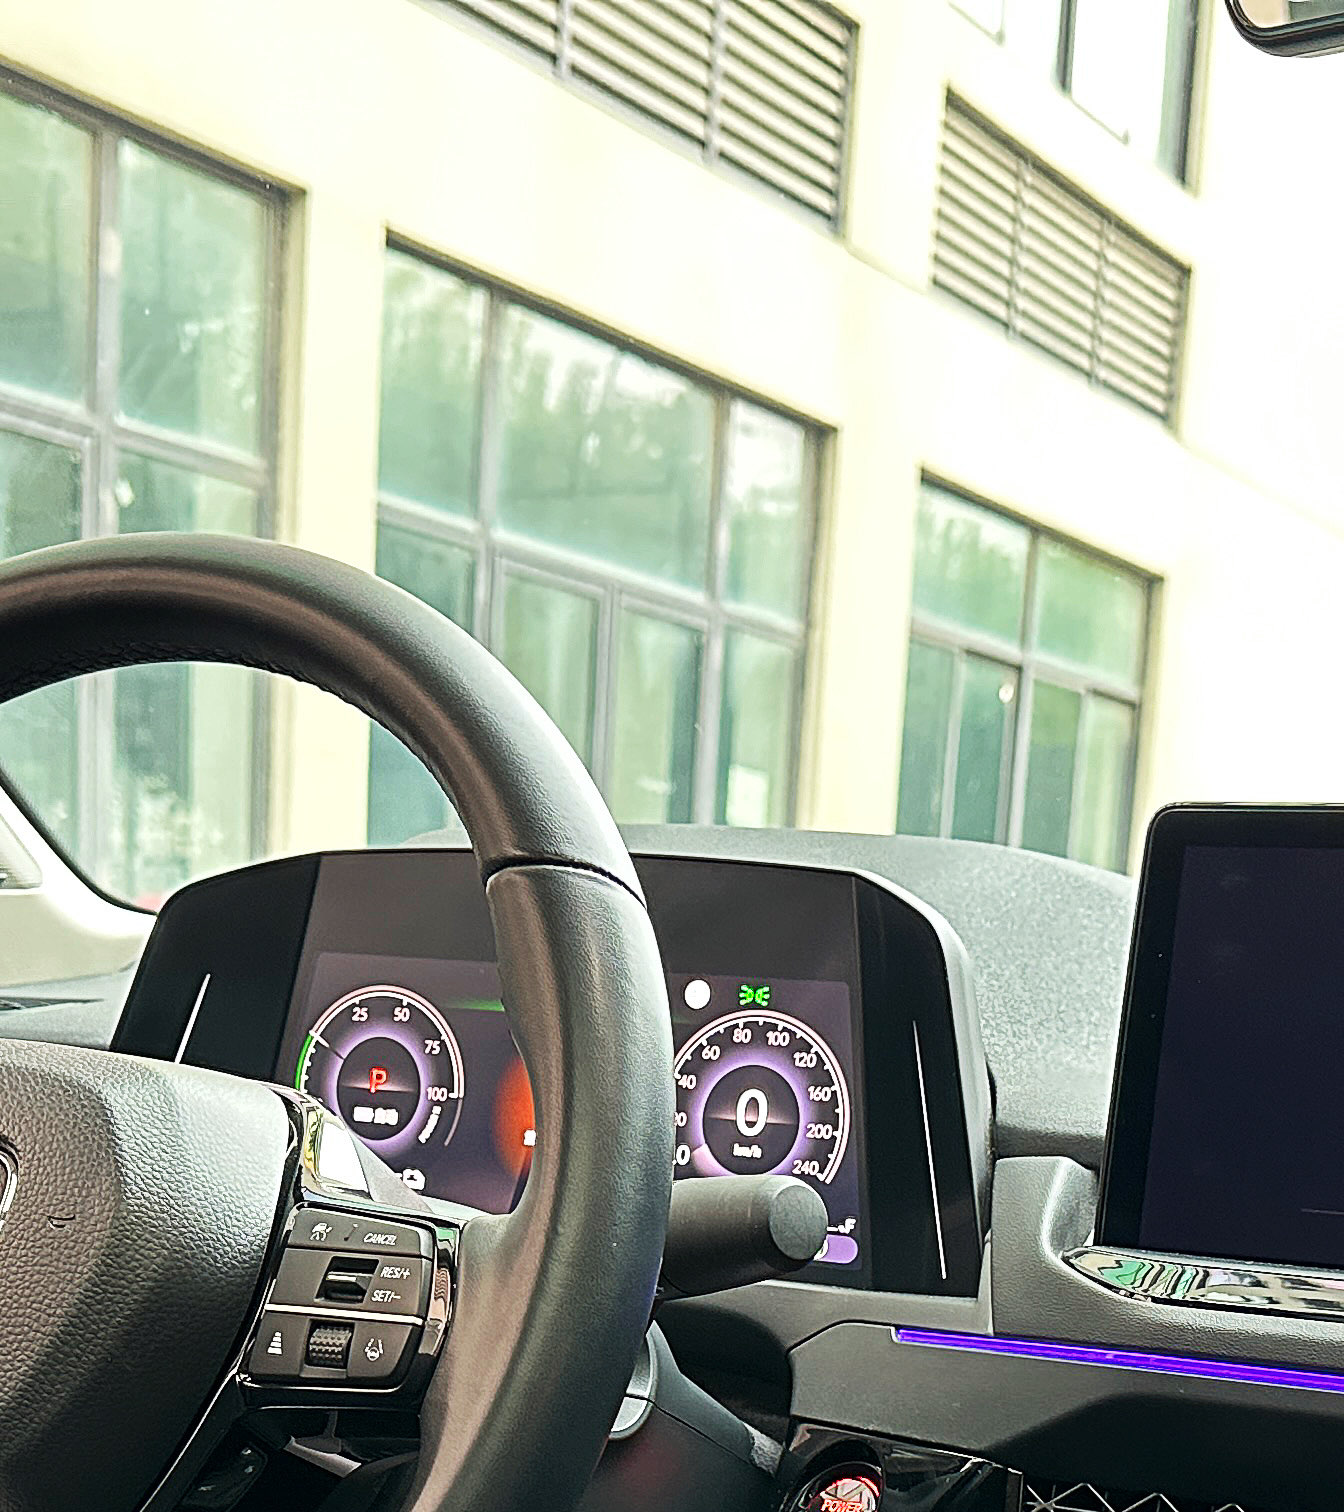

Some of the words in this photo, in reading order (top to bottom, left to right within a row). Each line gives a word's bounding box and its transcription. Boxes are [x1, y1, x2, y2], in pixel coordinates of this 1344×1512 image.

[351, 1008, 368, 1022] 25
[393, 1008, 410, 1022] 50
[733, 1028, 751, 1043] 80
[766, 1031, 790, 1046] 100
[424, 1040, 440, 1054] 75
[702, 1045, 720, 1060] 60
[794, 1052, 817, 1068] 120
[370, 1069, 387, 1093] P
[678, 1074, 697, 1090] 40
[427, 1087, 447, 1101] 100
[808, 1086, 832, 1102] 160
[736, 1088, 769, 1137] 0
[806, 1124, 833, 1139] 200
[792, 1160, 820, 1176] 240
[364, 1232, 396, 1245] CANCEL
